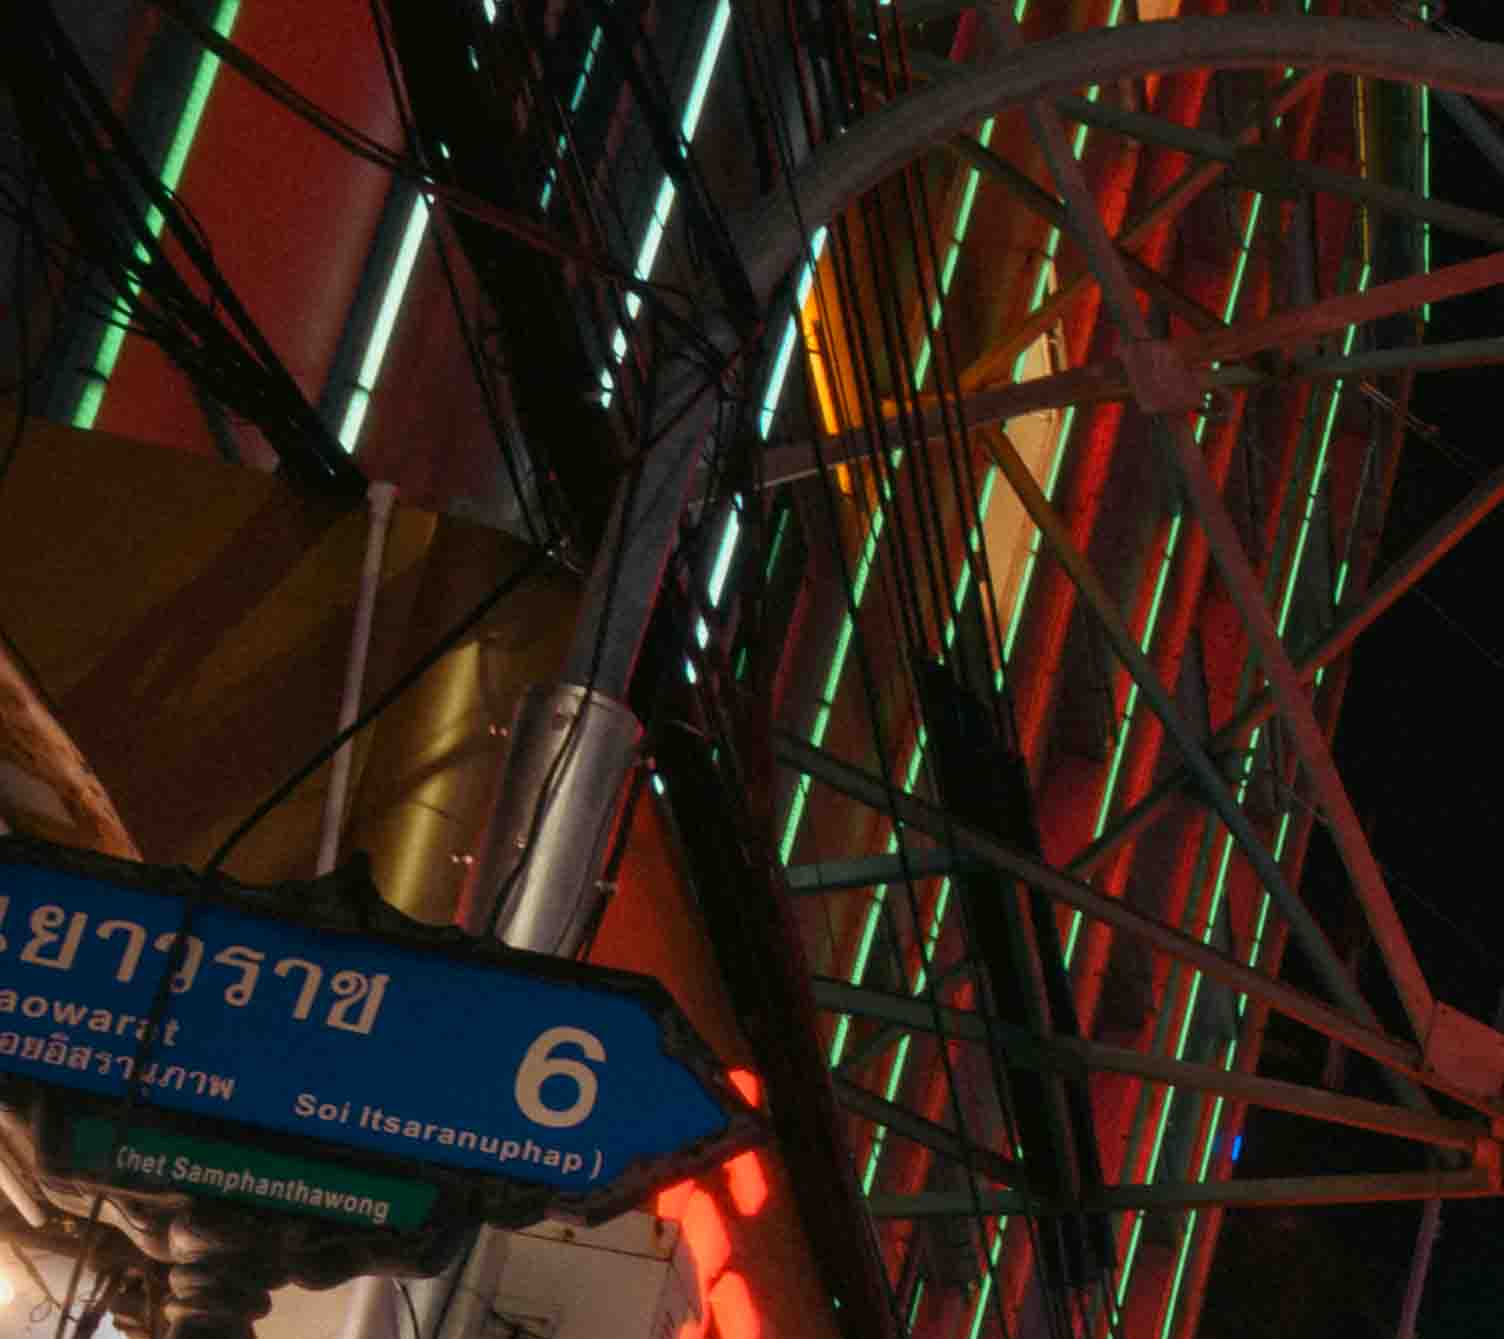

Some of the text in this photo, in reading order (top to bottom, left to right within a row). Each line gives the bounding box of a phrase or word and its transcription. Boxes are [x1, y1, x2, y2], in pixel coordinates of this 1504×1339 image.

[516, 1026, 607, 1128] 6
[294, 1093, 352, 1124] Soi
[359, 1104, 584, 1174] Itsaranuphap
[171, 1155, 391, 1225] Samphanthawong
